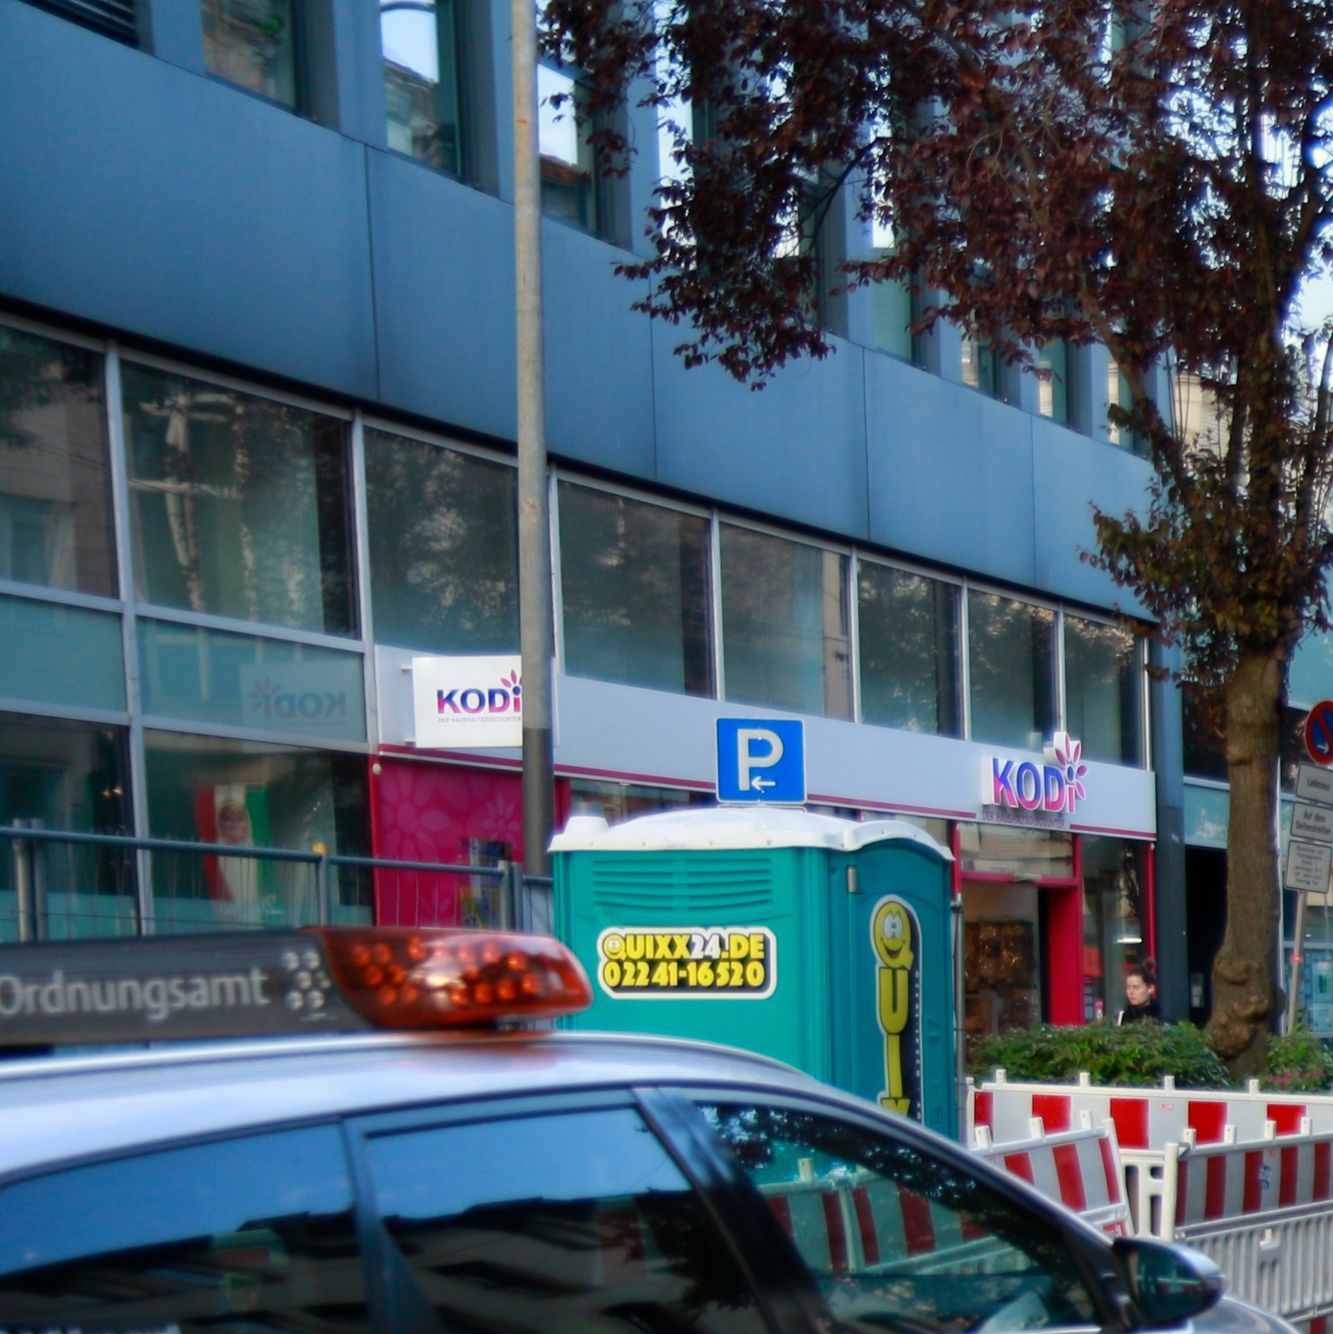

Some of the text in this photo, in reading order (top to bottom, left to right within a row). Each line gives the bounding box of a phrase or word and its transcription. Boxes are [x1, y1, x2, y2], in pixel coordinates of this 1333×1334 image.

[737, 728, 784, 791] P
[602, 932, 766, 961] QUIXX24.DE
[0, 967, 271, 1022] Ordnungsamt
